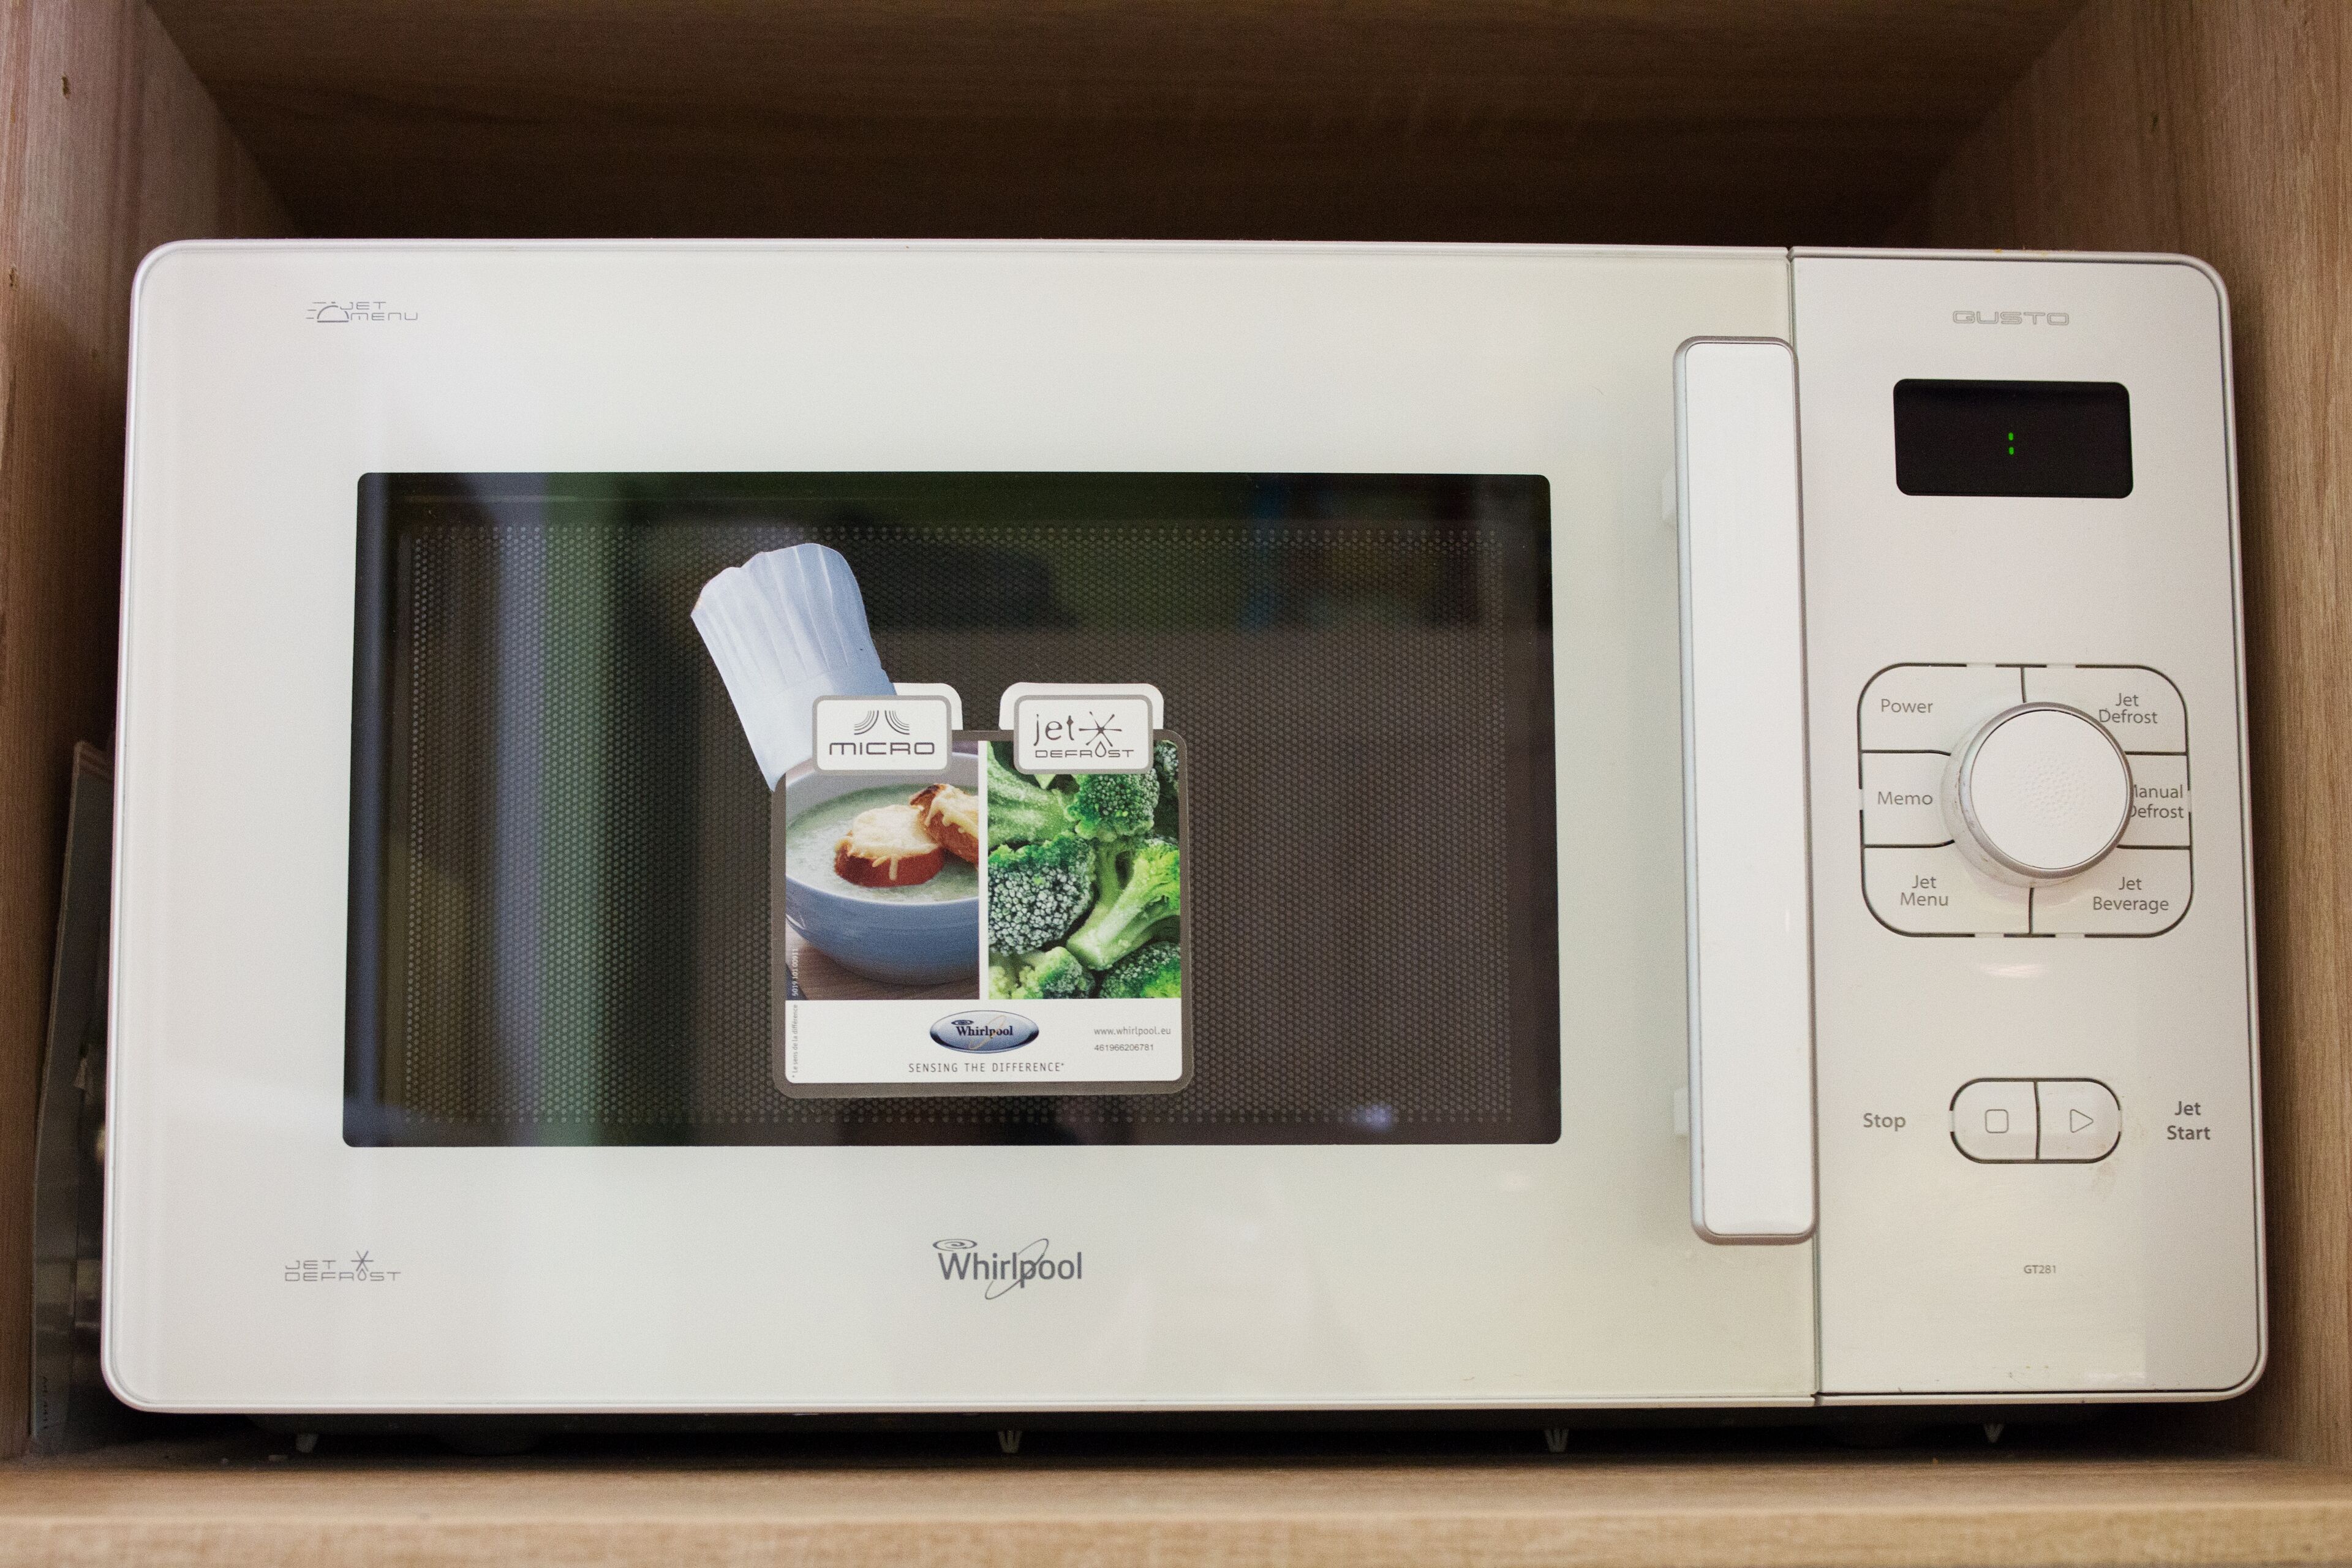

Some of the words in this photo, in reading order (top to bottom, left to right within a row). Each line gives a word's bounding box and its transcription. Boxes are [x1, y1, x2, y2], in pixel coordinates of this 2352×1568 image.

[1953, 311, 2070, 326] GUSTO
[1881, 698, 1934, 714] Power
[2115, 693, 2139, 707] Jet
[2098, 709, 2158, 724] Defrost
[1033, 714, 1074, 747] jet
[829, 742, 935, 755] MICRO
[1035, 741, 1134, 758] DEFROST
[1877, 791, 1934, 805] Memo
[1911, 875, 1937, 889] Jet
[2118, 876, 2143, 891] Jet
[1900, 892, 1949, 907] Menu
[2092, 896, 2169, 914] Beverage
[956, 1026, 1014, 1039] Whirlpool
[1094, 1027, 1170, 1036] www.whirlpool.eu
[1094, 1043, 1153, 1052] 461966206781
[909, 1063, 957, 1072] SENSING
[965, 1063, 984, 1072] THE
[2175, 1101, 2201, 1115] Jet
[1863, 1112, 1906, 1132] Stop
[2167, 1126, 2211, 1140] Start
[285, 1260, 336, 1270] JET
[938, 1251, 1082, 1289] Whirlpool
[2023, 1264, 2057, 1274] GT281
